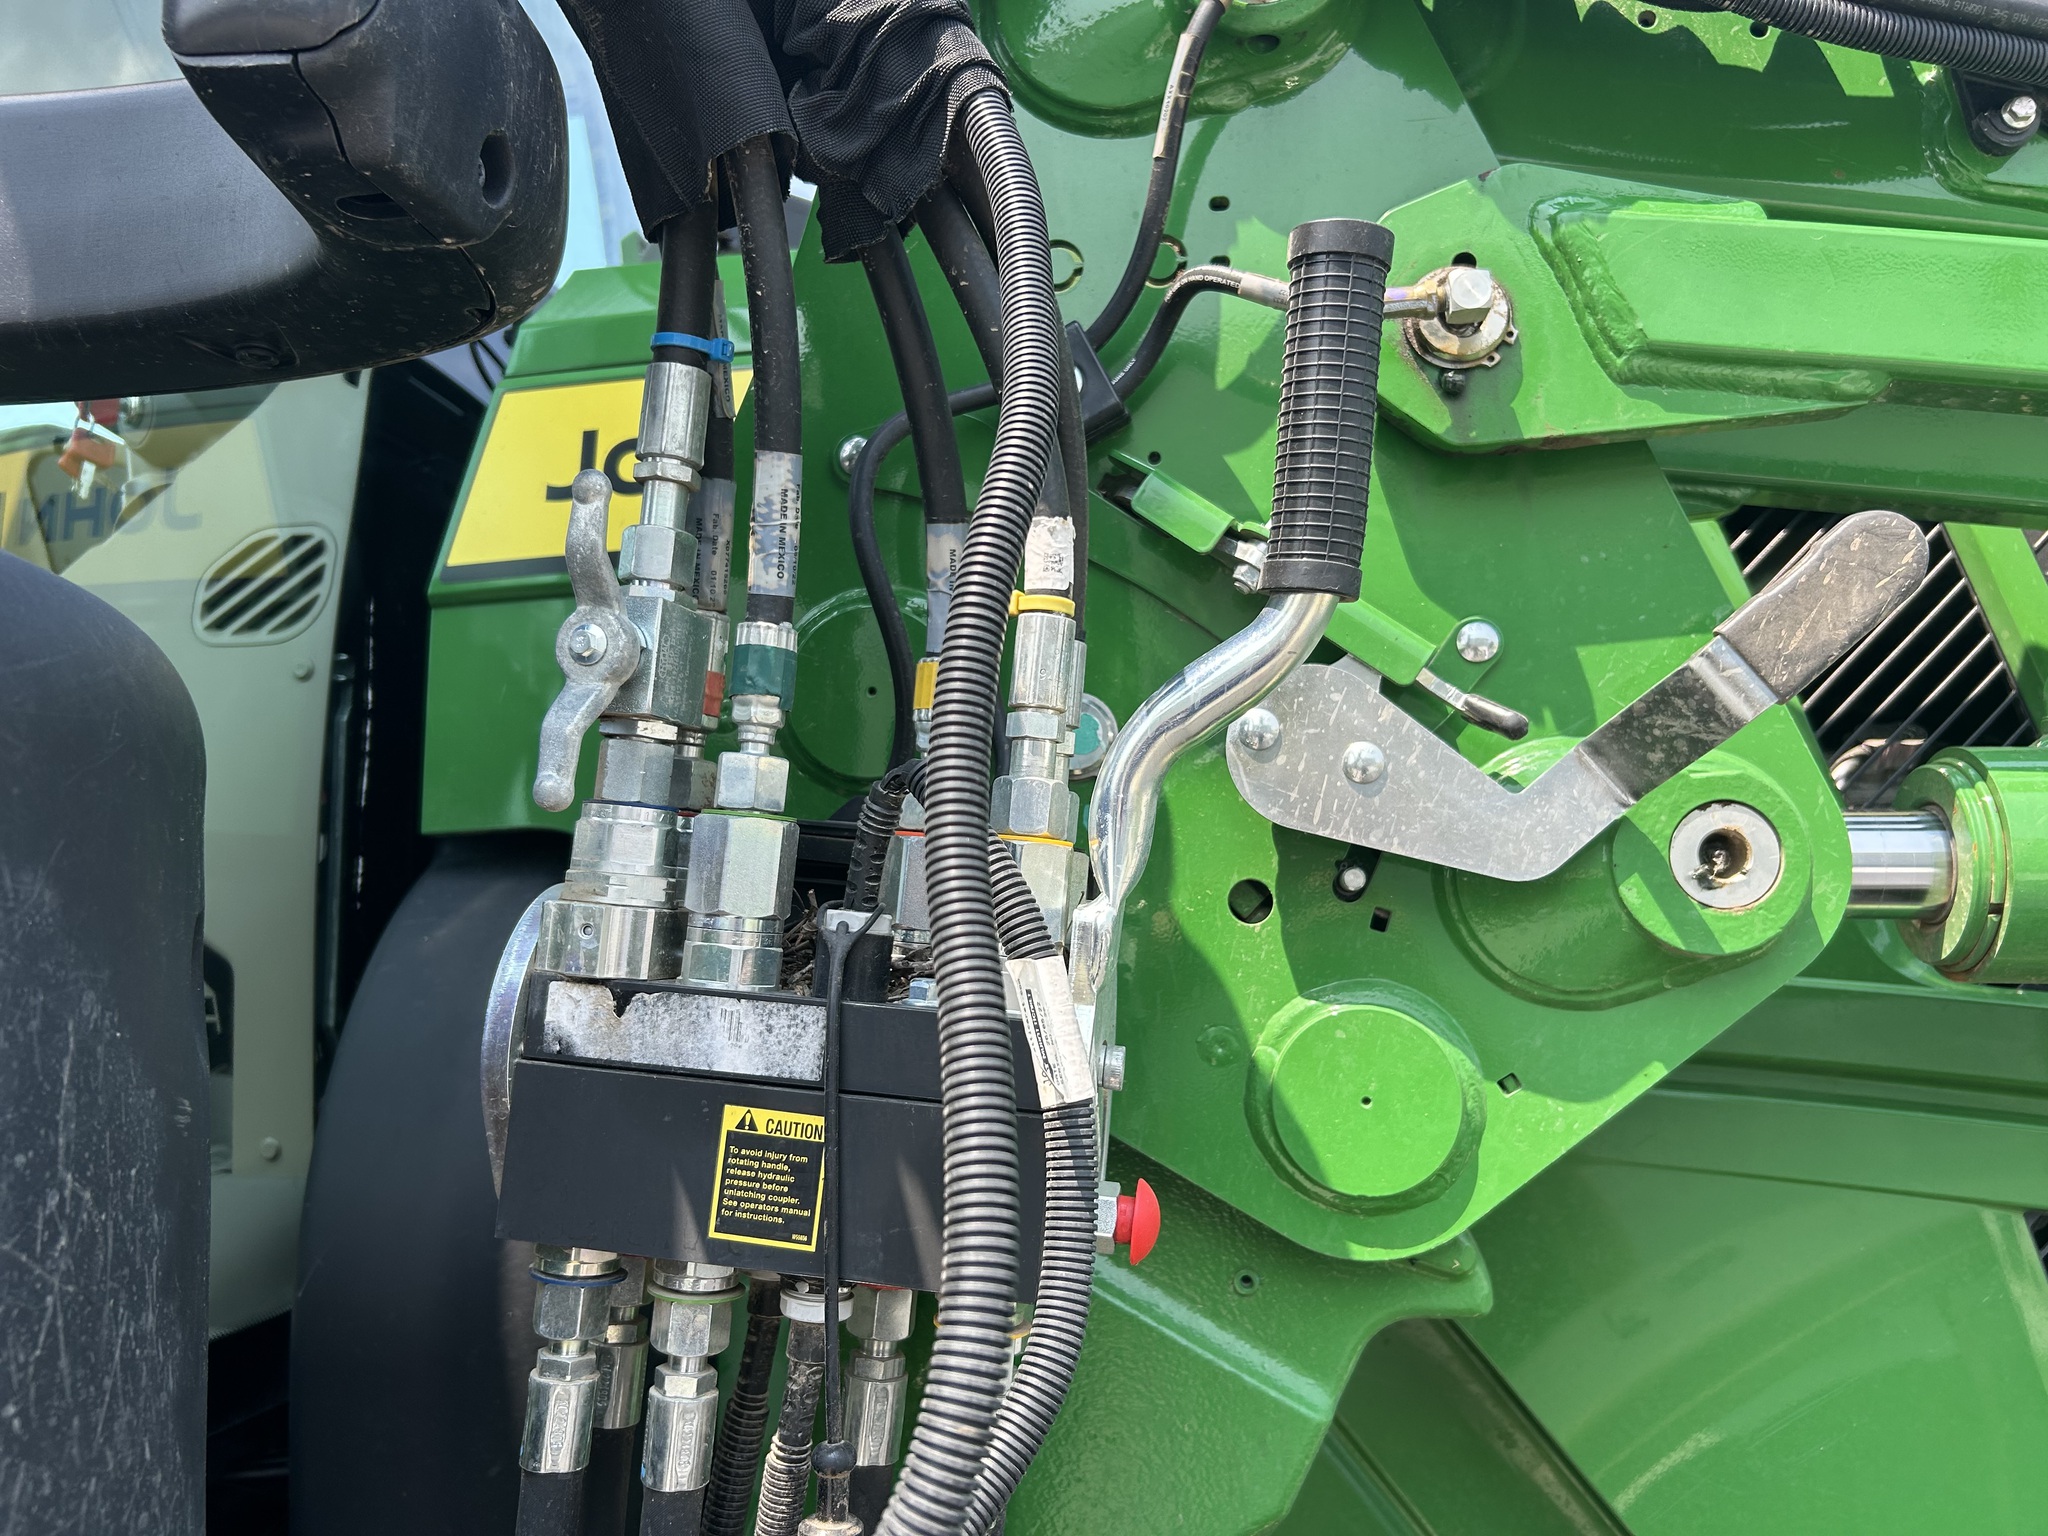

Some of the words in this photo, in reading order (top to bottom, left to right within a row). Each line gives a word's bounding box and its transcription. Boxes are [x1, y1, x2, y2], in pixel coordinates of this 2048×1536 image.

[1204, 275, 1241, 288] OPERATED
[780, 488, 789, 520] MADE
[779, 523, 788, 535] IN
[711, 535, 719, 556] Date
[776, 536, 788, 580] MEXICO
[765, 1118, 824, 1141] CAUTION
[729, 1145, 739, 1154] To
[740, 1146, 763, 1157] avoid
[764, 1149, 788, 1162] injury
[789, 1153, 808, 1164] from
[727, 1157, 759, 1169] rotating
[761, 1159, 791, 1172] handle,
[726, 1167, 756, 1178] release
[757, 1169, 796, 1184] hydraulic
[724, 1178, 761, 1190] pressure
[762, 1181, 789, 1192] before
[723, 1188, 767, 1202] unlatching
[767, 1193, 801, 1205] coupler.
[722, 1198, 738, 1207] See
[739, 1200, 780, 1213] operators
[780, 1206, 811, 1217] manual
[721, 1208, 734, 1217] for
[734, 1210, 786, 1225] instructions.
